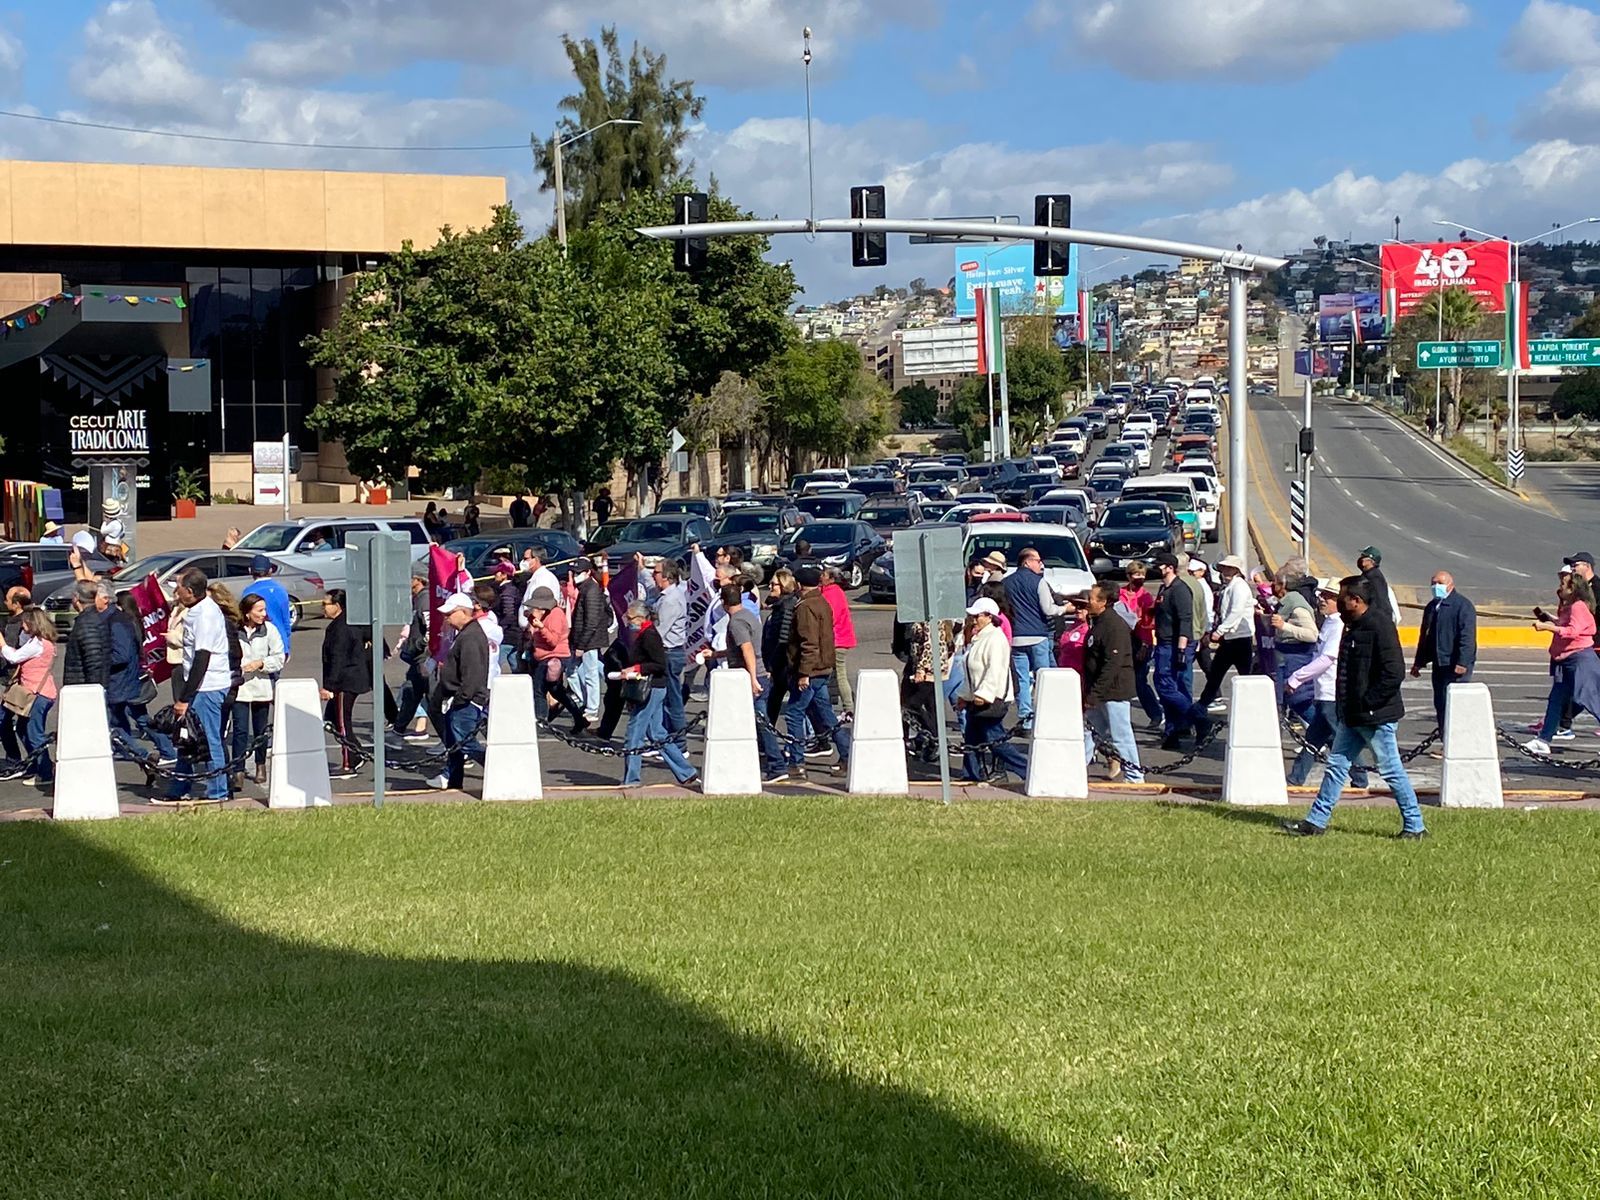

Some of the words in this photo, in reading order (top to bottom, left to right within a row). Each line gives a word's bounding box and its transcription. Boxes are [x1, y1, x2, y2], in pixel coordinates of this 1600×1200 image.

[1414, 248, 1475, 278] 40
[1003, 266, 1025, 275] Silver
[1441, 278, 1476, 286] TIJUANA
[1438, 355, 1489, 363] AYUNTAMIENTO
[70, 415, 115, 428] CECUT
[116, 409, 147, 429] ARTE
[69, 429, 150, 450] TRADICIONAL
